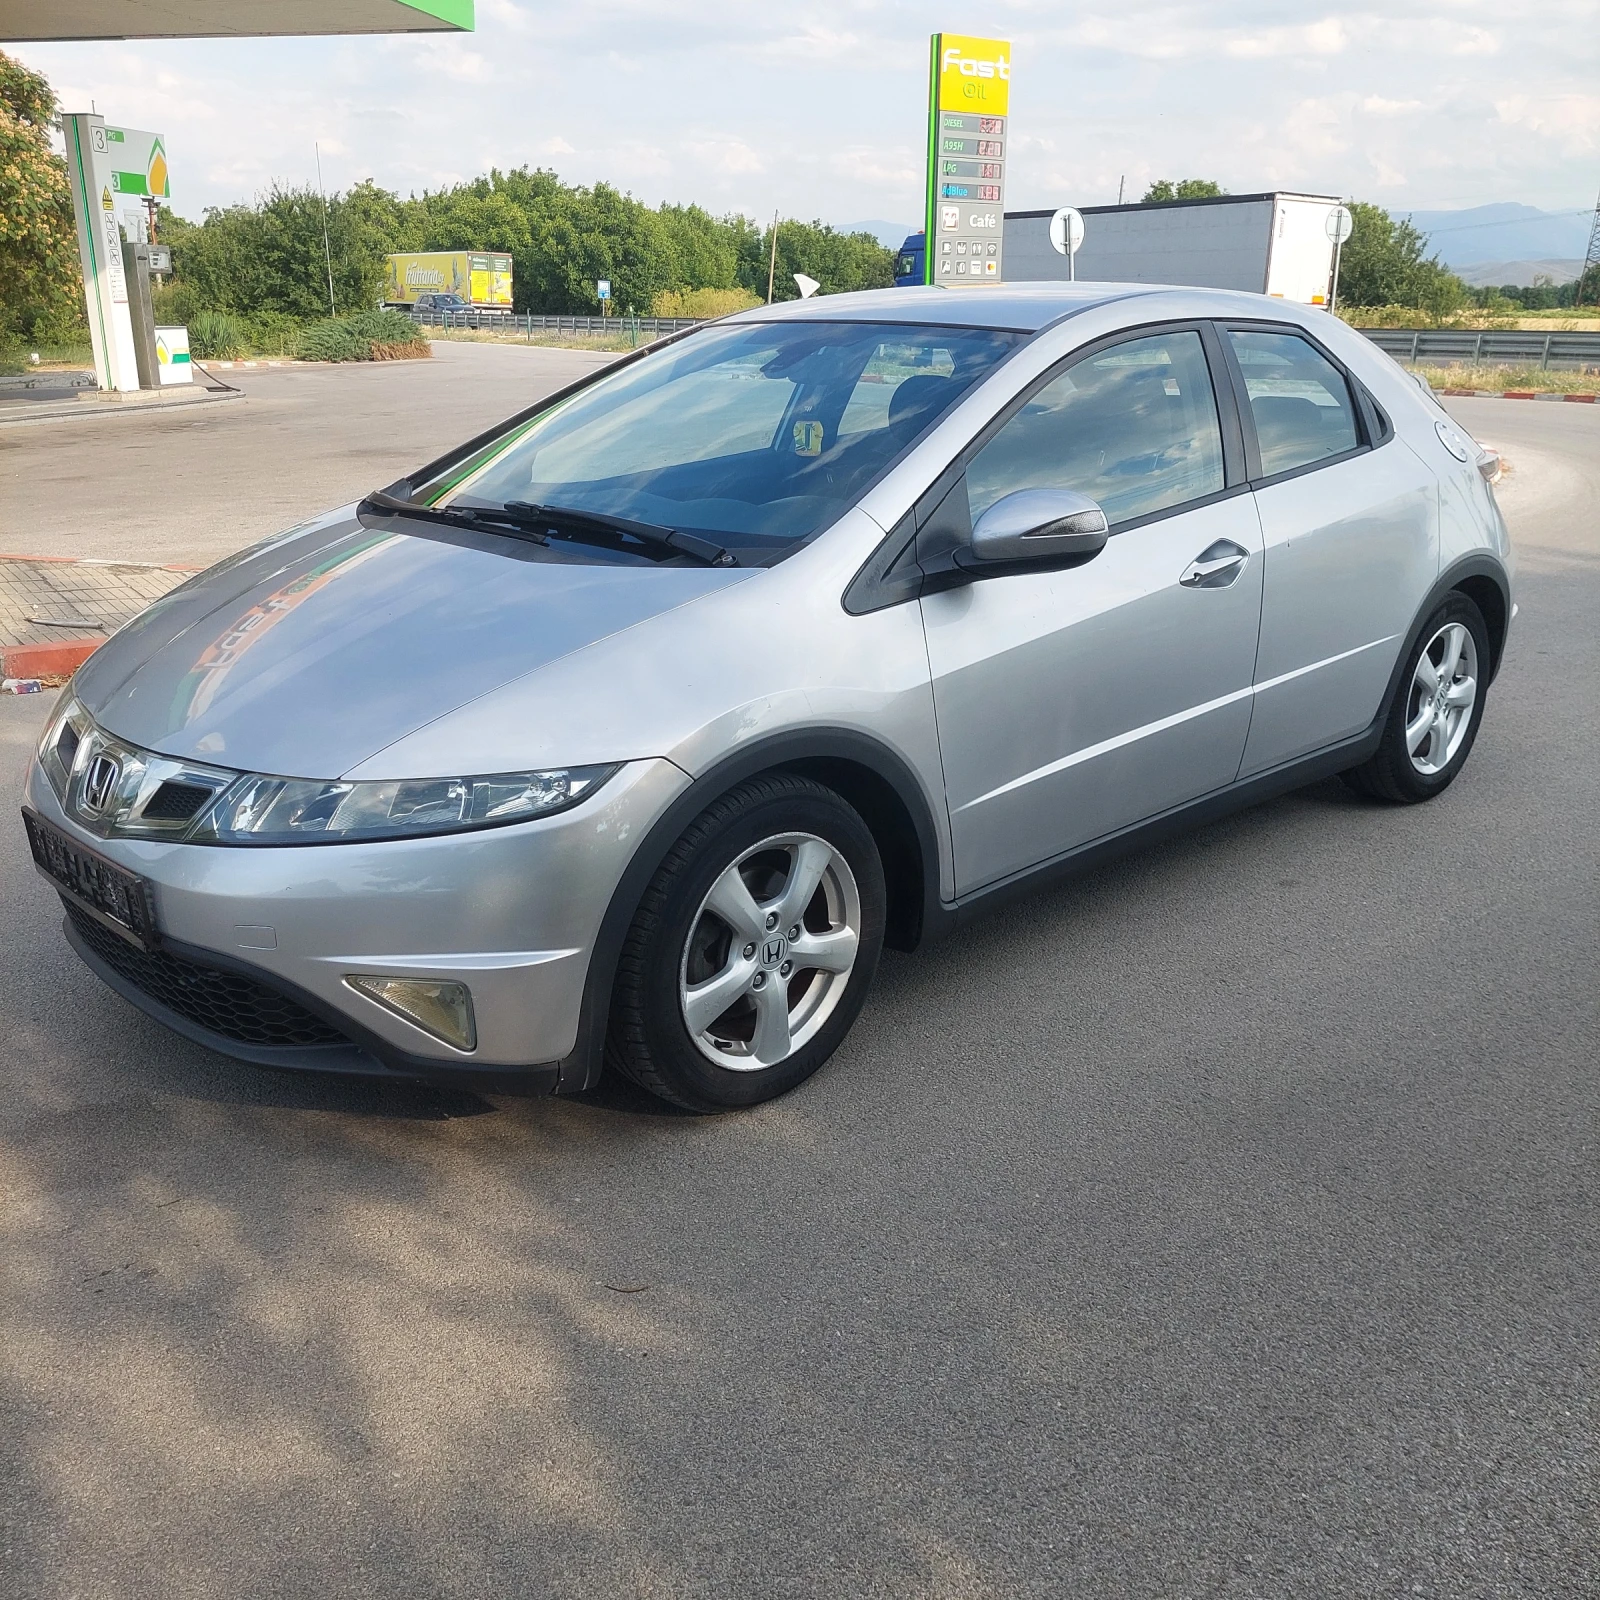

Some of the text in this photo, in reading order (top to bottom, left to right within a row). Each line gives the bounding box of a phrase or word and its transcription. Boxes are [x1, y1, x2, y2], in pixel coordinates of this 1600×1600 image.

[963, 82, 987, 100] Oil
[944, 118, 964, 128] DIESEL
[95, 130, 105, 150] 3
[943, 140, 964, 151] A95H
[943, 163, 957, 173] LPG
[942, 185, 968, 196] AdBlue
[969, 213, 996, 228] Café
